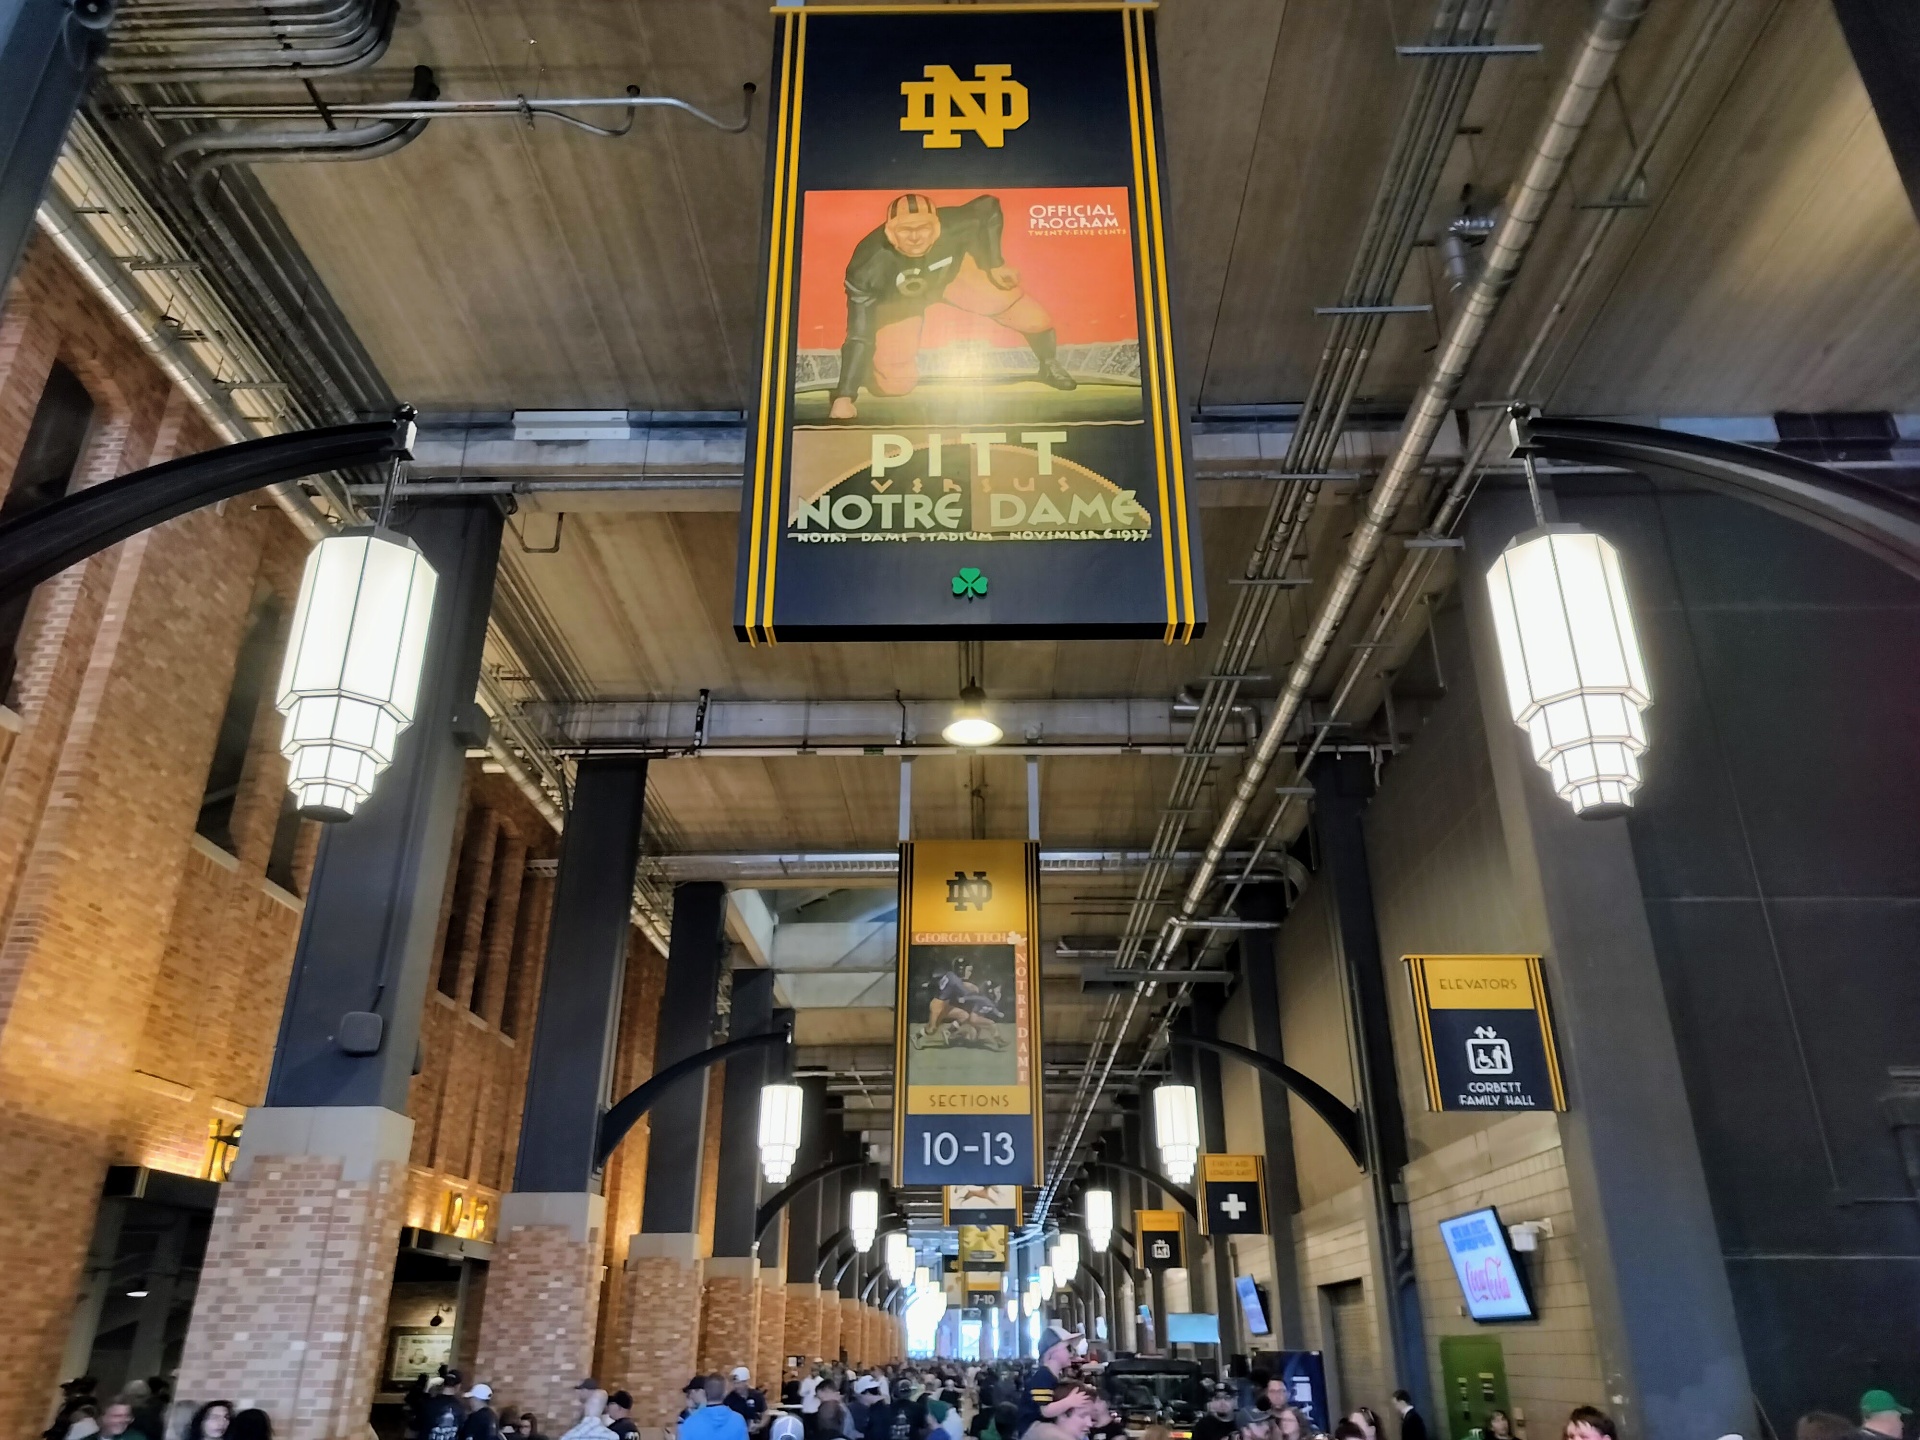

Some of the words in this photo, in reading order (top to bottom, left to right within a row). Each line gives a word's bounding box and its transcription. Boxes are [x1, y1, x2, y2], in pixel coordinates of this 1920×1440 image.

[900, 64, 1029, 148] ND
[1029, 204, 1115, 218] OFFICIAL
[1030, 217, 1119, 229] PROGRAM
[870, 431, 1067, 478] PITT
[797, 491, 964, 530] NOTRE
[990, 489, 1137, 527] DAME
[797, 532, 848, 543] NOTRE
[861, 532, 908, 543] DAME
[919, 531, 993, 543] STADIUM
[1009, 530, 1101, 540] NOVEMBER
[1103, 528, 1113, 540] 6
[1116, 529, 1148, 541] 1937
[915, 932, 971, 943] GEORGIA
[974, 932, 1007, 943] TECH
[1016, 952, 1027, 1019] NOTRE
[1440, 978, 1518, 990] ELEVATORS
[1017, 1027, 1029, 1082] DAME
[1468, 1081, 1522, 1094] CORBETT
[929, 1094, 1010, 1107] SECTIONS
[1459, 1094, 1501, 1106] FAMILY
[1505, 1094, 1535, 1106] HALL
[922, 1131, 1015, 1166] 10-13
[973, 1294, 996, 1305] 7-10
